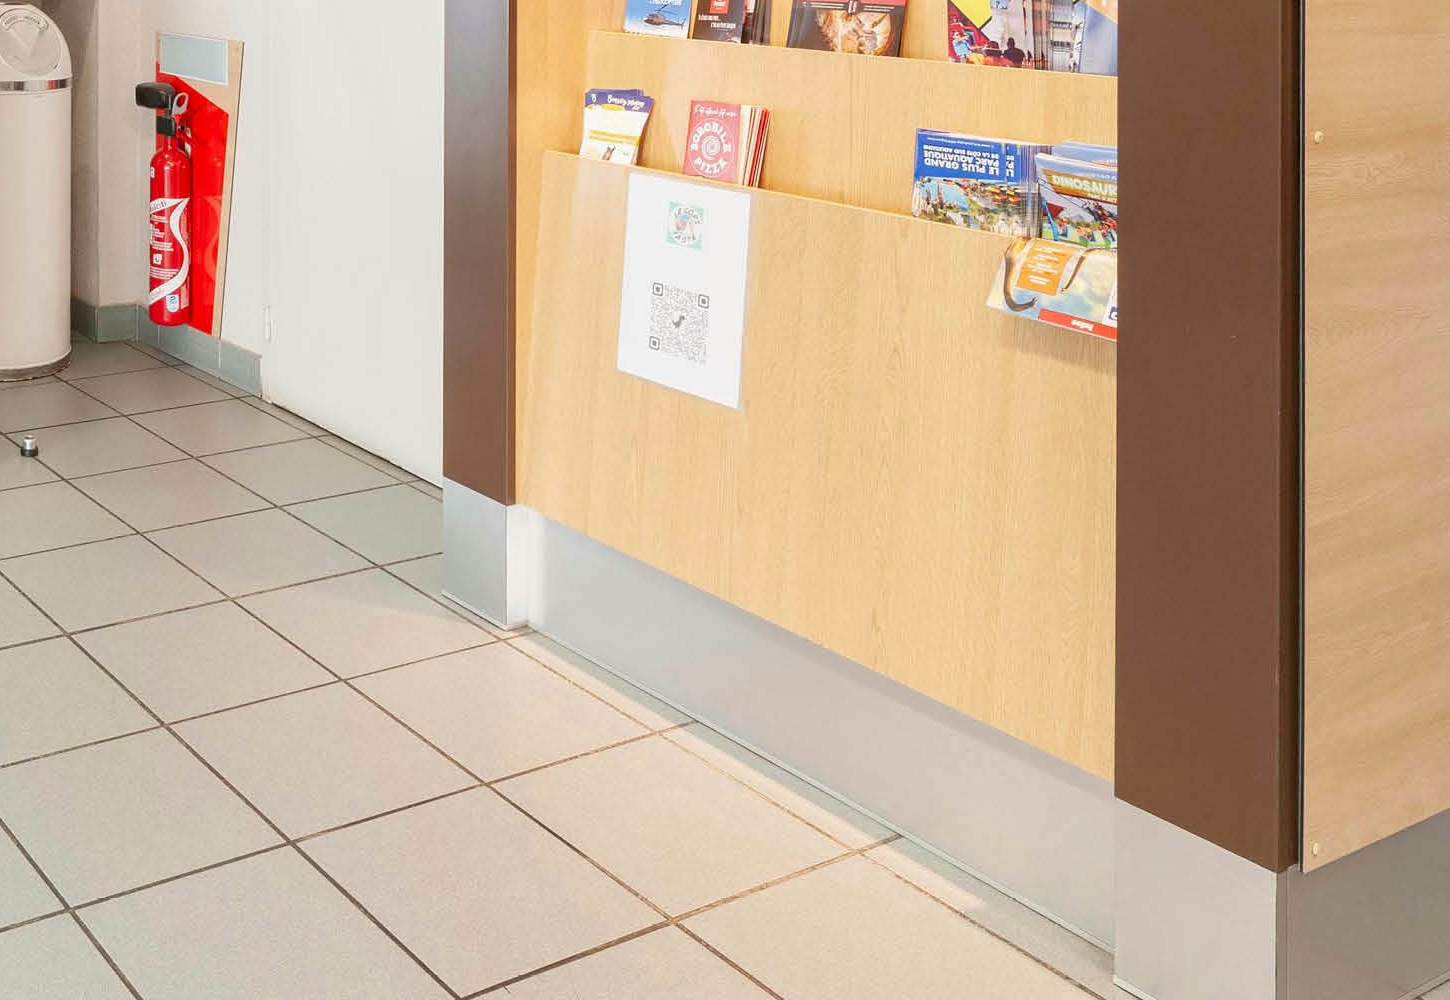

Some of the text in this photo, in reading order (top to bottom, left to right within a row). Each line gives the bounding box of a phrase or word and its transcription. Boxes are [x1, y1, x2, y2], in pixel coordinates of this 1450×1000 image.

[923, 150, 973, 163] AQUATIQUE
[924, 158, 960, 170] GRAND
[961, 162, 986, 174] PLUS
